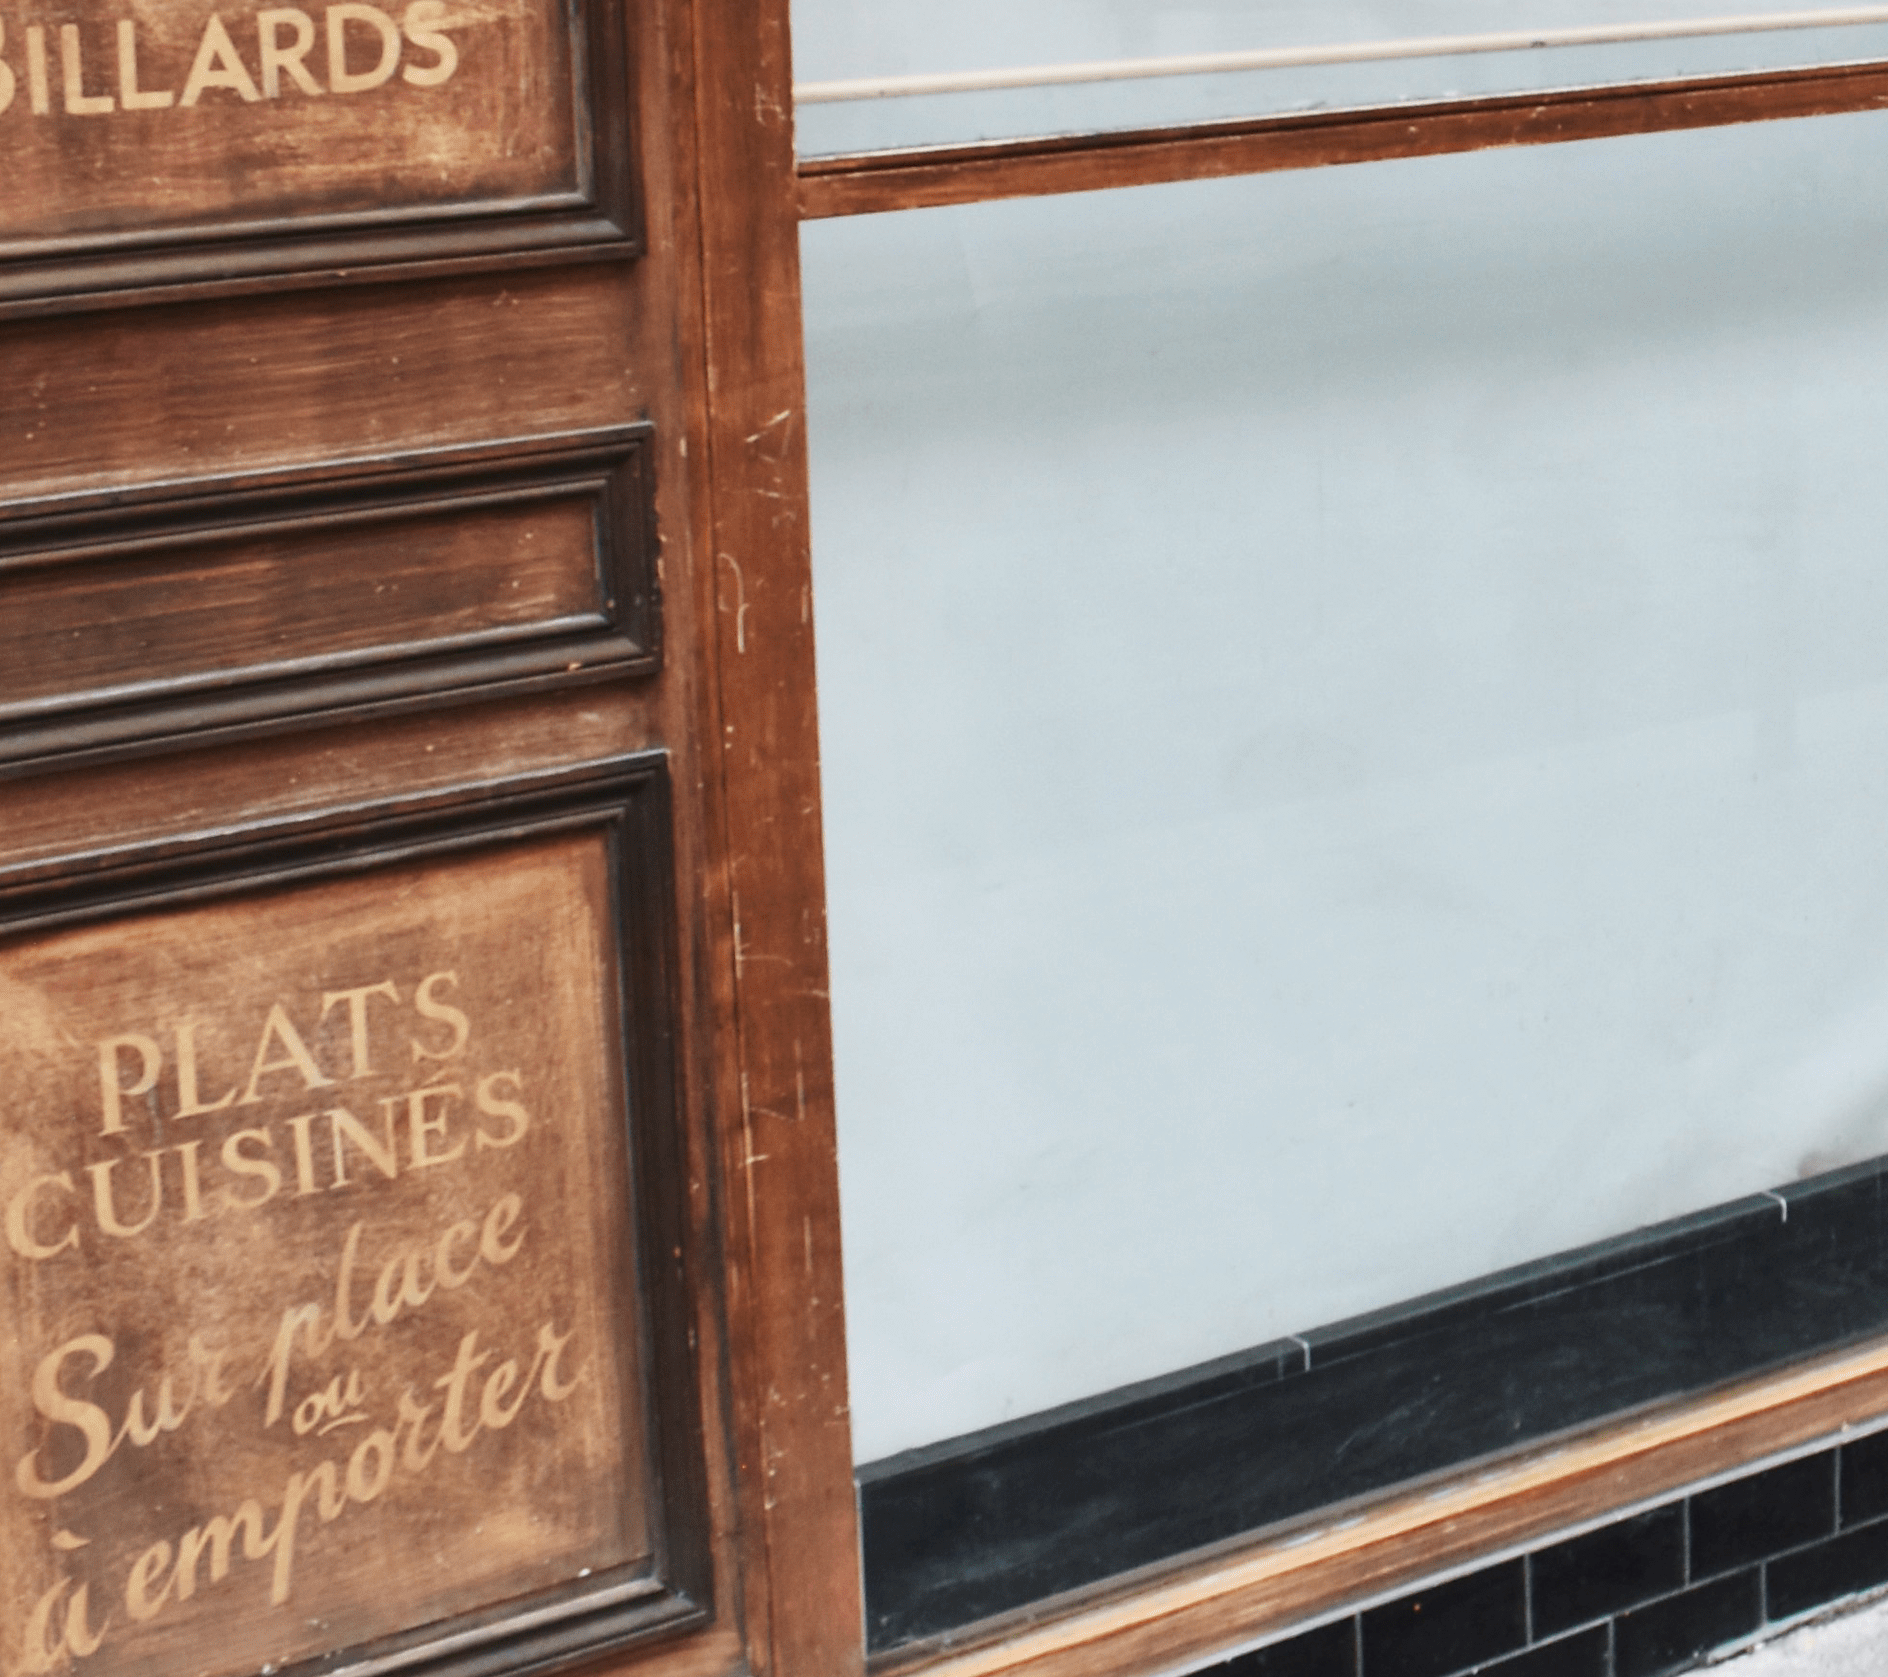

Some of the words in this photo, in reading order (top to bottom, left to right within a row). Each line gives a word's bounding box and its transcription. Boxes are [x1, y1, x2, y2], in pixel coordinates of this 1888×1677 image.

[99, 969, 471, 1137] PLATS
[15, 1332, 237, 1499] Sur
[254, 1193, 531, 1429] place
[292, 1368, 372, 1436] ou
[124, 1321, 592, 1609] emporter
